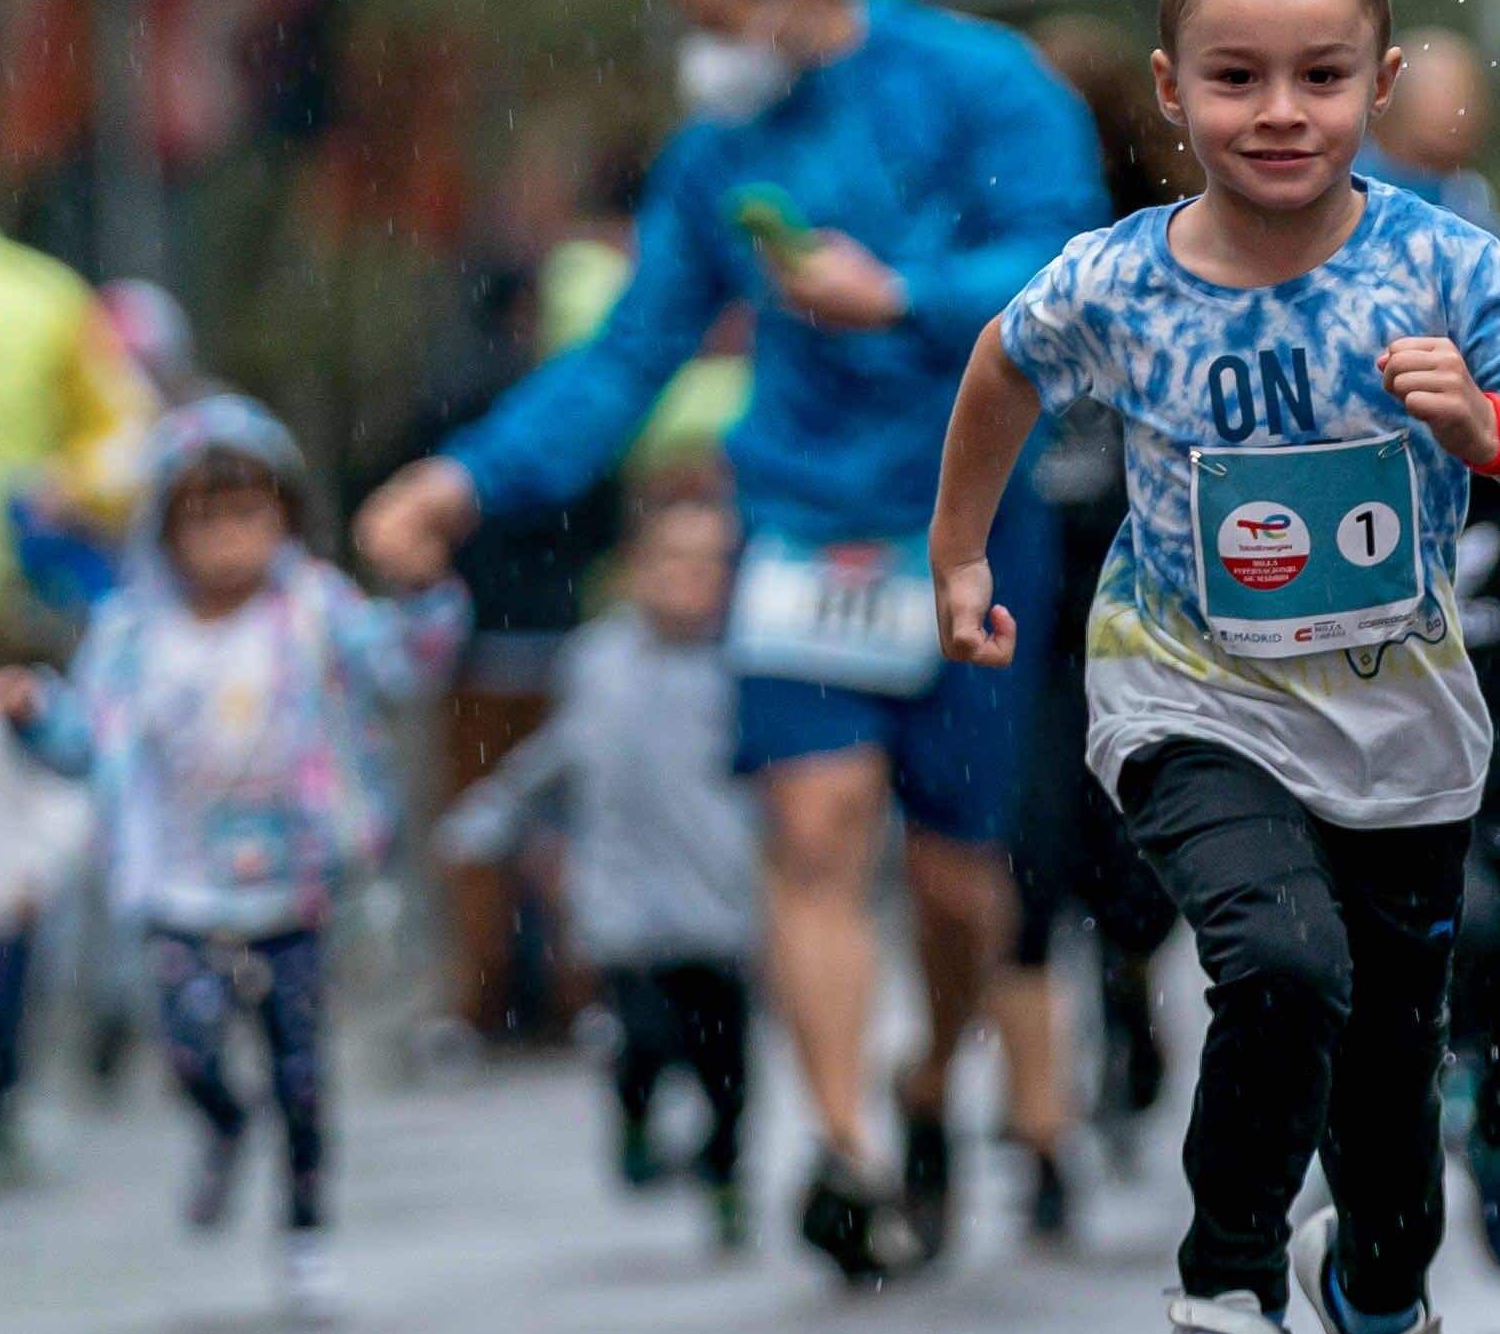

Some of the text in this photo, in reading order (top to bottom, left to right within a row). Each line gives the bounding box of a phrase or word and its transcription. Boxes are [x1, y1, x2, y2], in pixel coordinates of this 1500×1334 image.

[1209, 347, 1316, 443] ON
[1356, 510, 1375, 557] 1
[1234, 632, 1282, 643] MADRID
